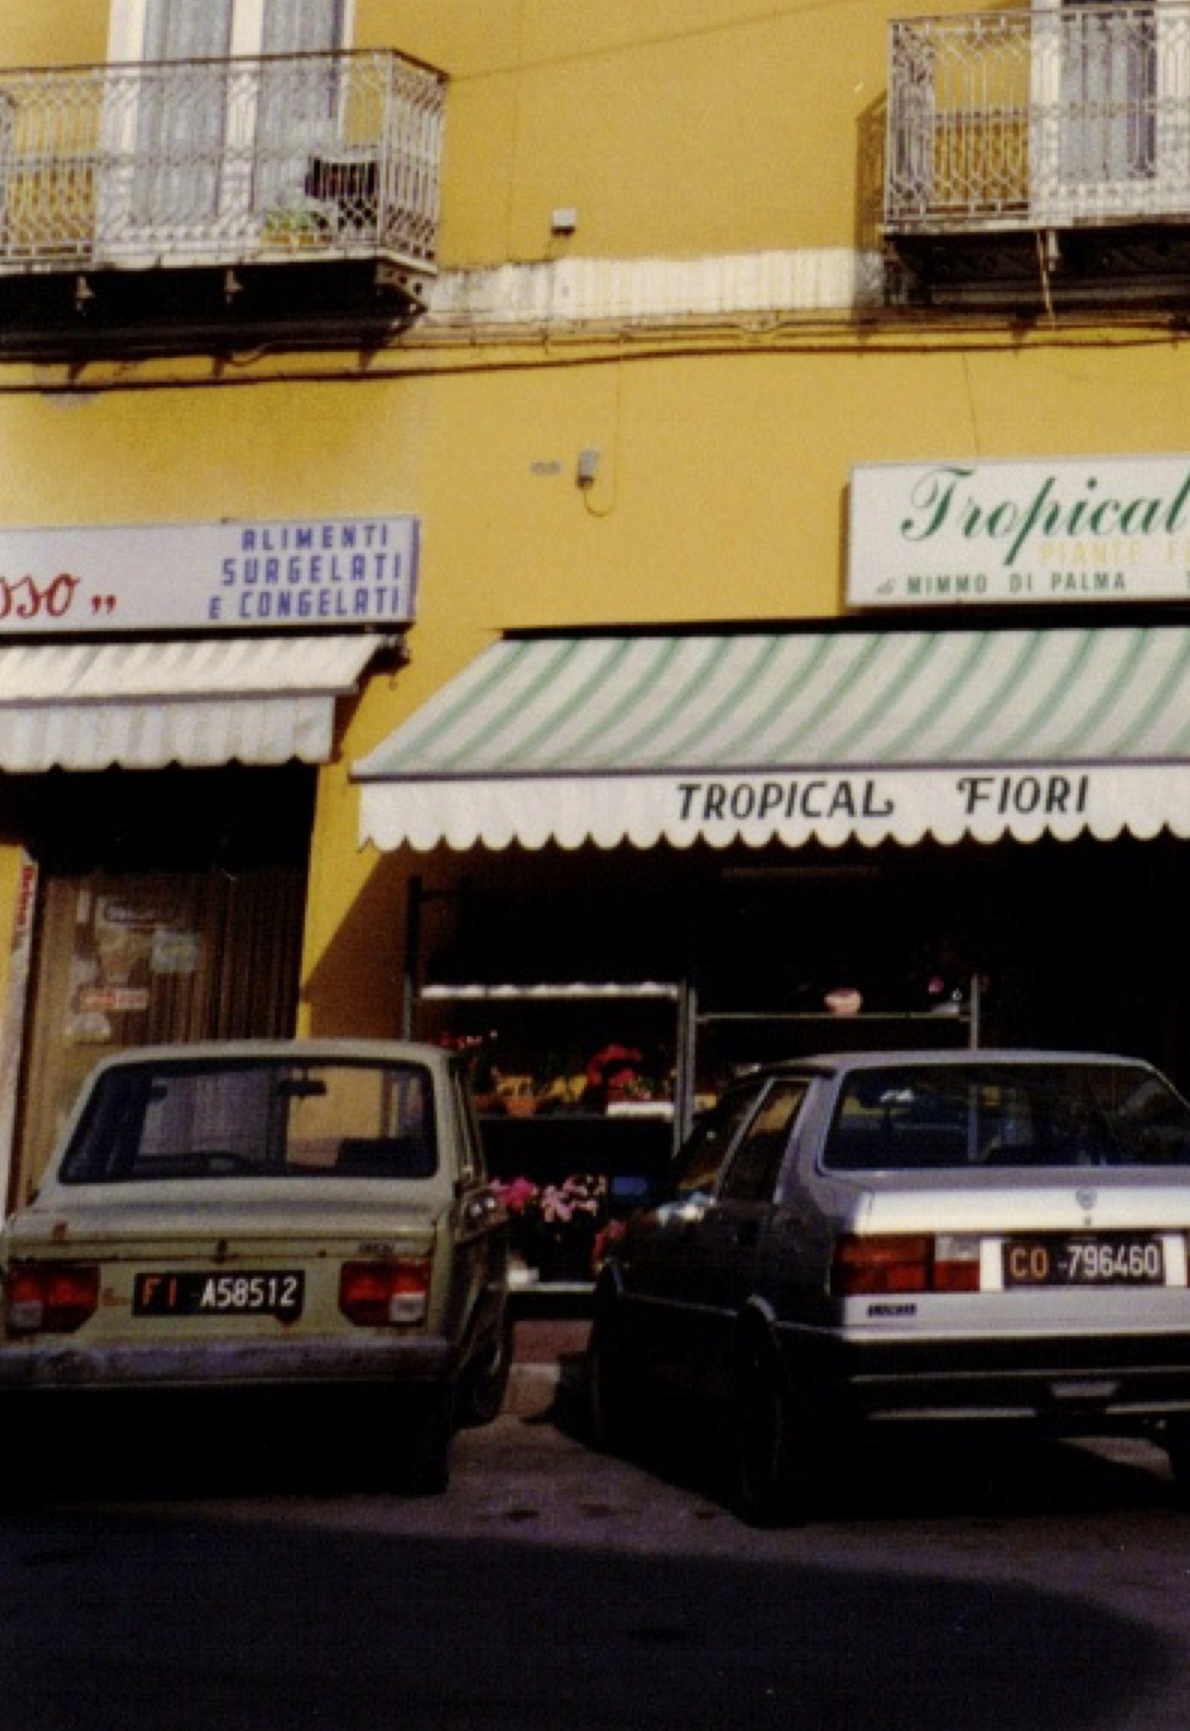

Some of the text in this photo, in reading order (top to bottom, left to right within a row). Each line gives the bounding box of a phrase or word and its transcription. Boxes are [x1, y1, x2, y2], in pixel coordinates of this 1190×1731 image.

[242, 523, 388, 551] ALIMENTI
[1038, 540, 1141, 565] PIANTE
[222, 553, 401, 587] SURGELATI
[907, 575, 988, 595] MIMMO
[1009, 573, 1034, 593] DI
[1050, 572, 1126, 591] PALMA
[209, 587, 400, 619] E CONGELATI
[677, 775, 1090, 820] TROPICAL FIORI
[1009, 1247, 1048, 1279] CO
[142, 1278, 178, 1306] FI
